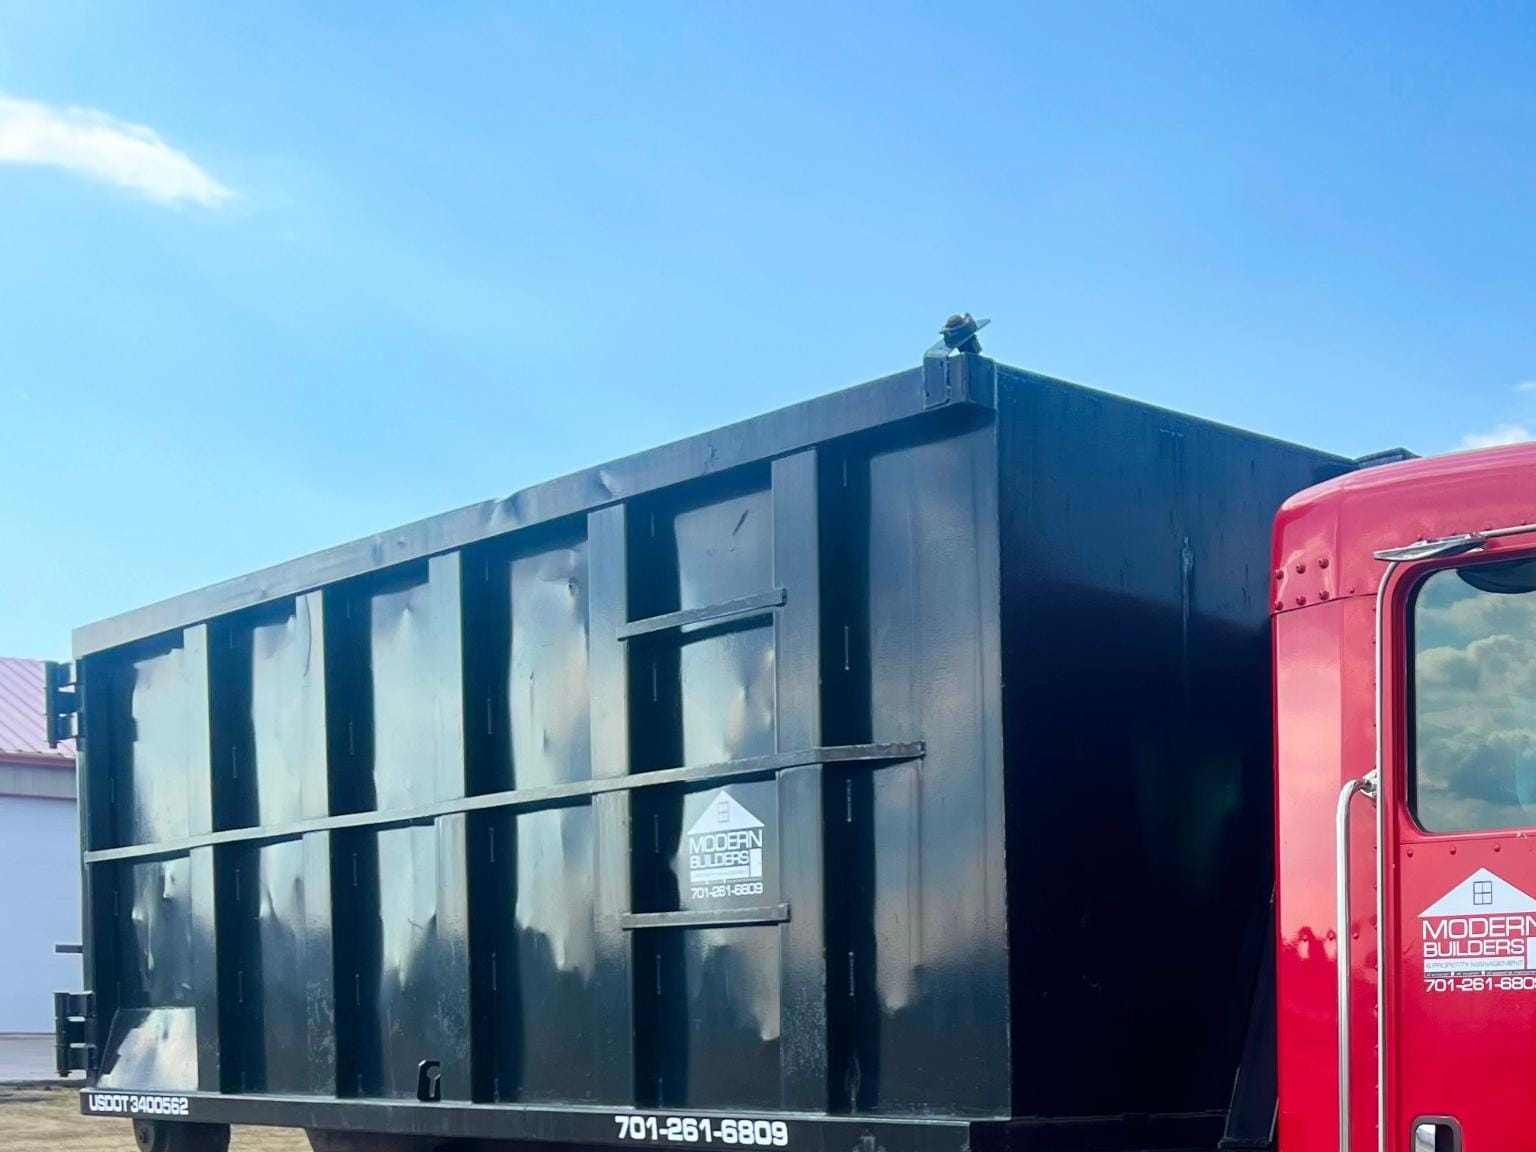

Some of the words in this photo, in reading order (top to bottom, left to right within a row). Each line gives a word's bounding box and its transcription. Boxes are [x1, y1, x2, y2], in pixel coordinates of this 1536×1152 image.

[689, 829, 763, 854] MODERN
[690, 851, 750, 869] BUILDERS
[691, 882, 763, 899] 701-261-6809
[1424, 939, 1524, 957] BUILDERS
[89, 1094, 129, 1112] USDOT
[130, 1096, 189, 1115] 3400562
[615, 1115, 788, 1146] 701-261-6809
